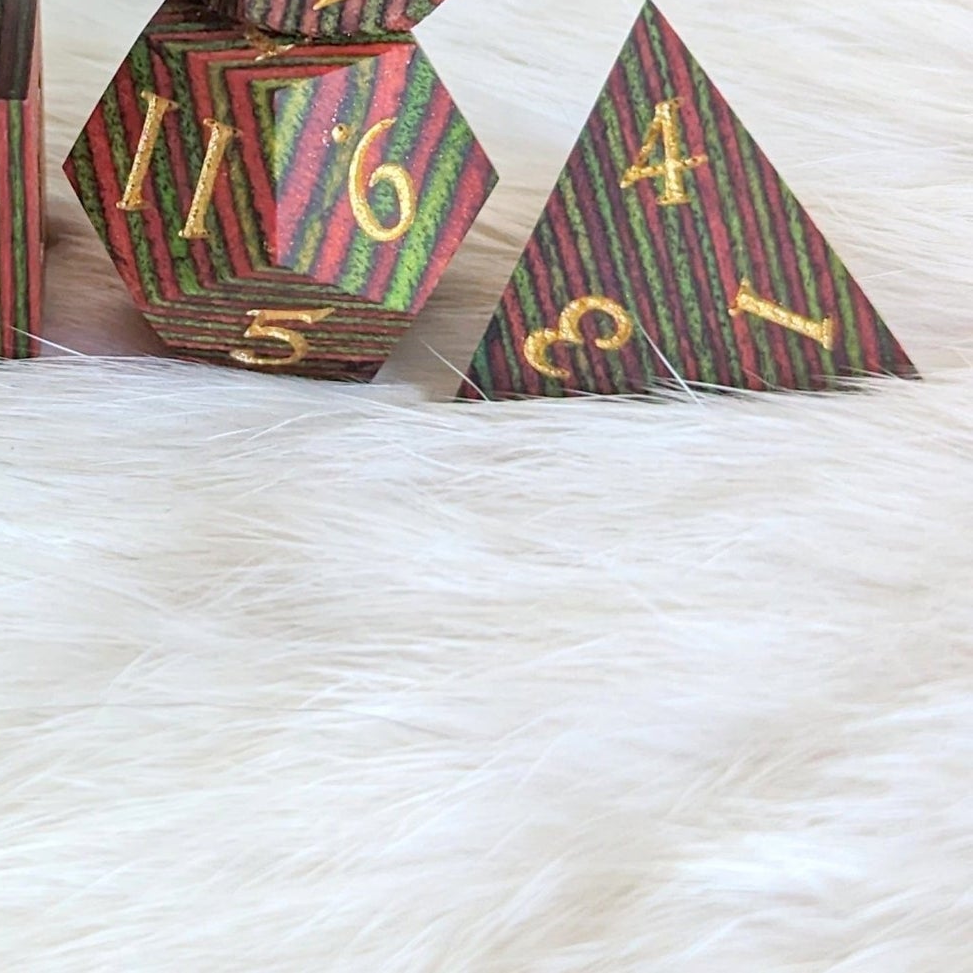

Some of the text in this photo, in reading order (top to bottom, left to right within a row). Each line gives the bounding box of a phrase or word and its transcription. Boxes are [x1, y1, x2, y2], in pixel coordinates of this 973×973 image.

[116, 90, 242, 239] 11
[620, 96, 708, 206] 4
[229, 307, 336, 366] 5
[524, 295, 632, 379] 3
[728, 277, 834, 351] 1
